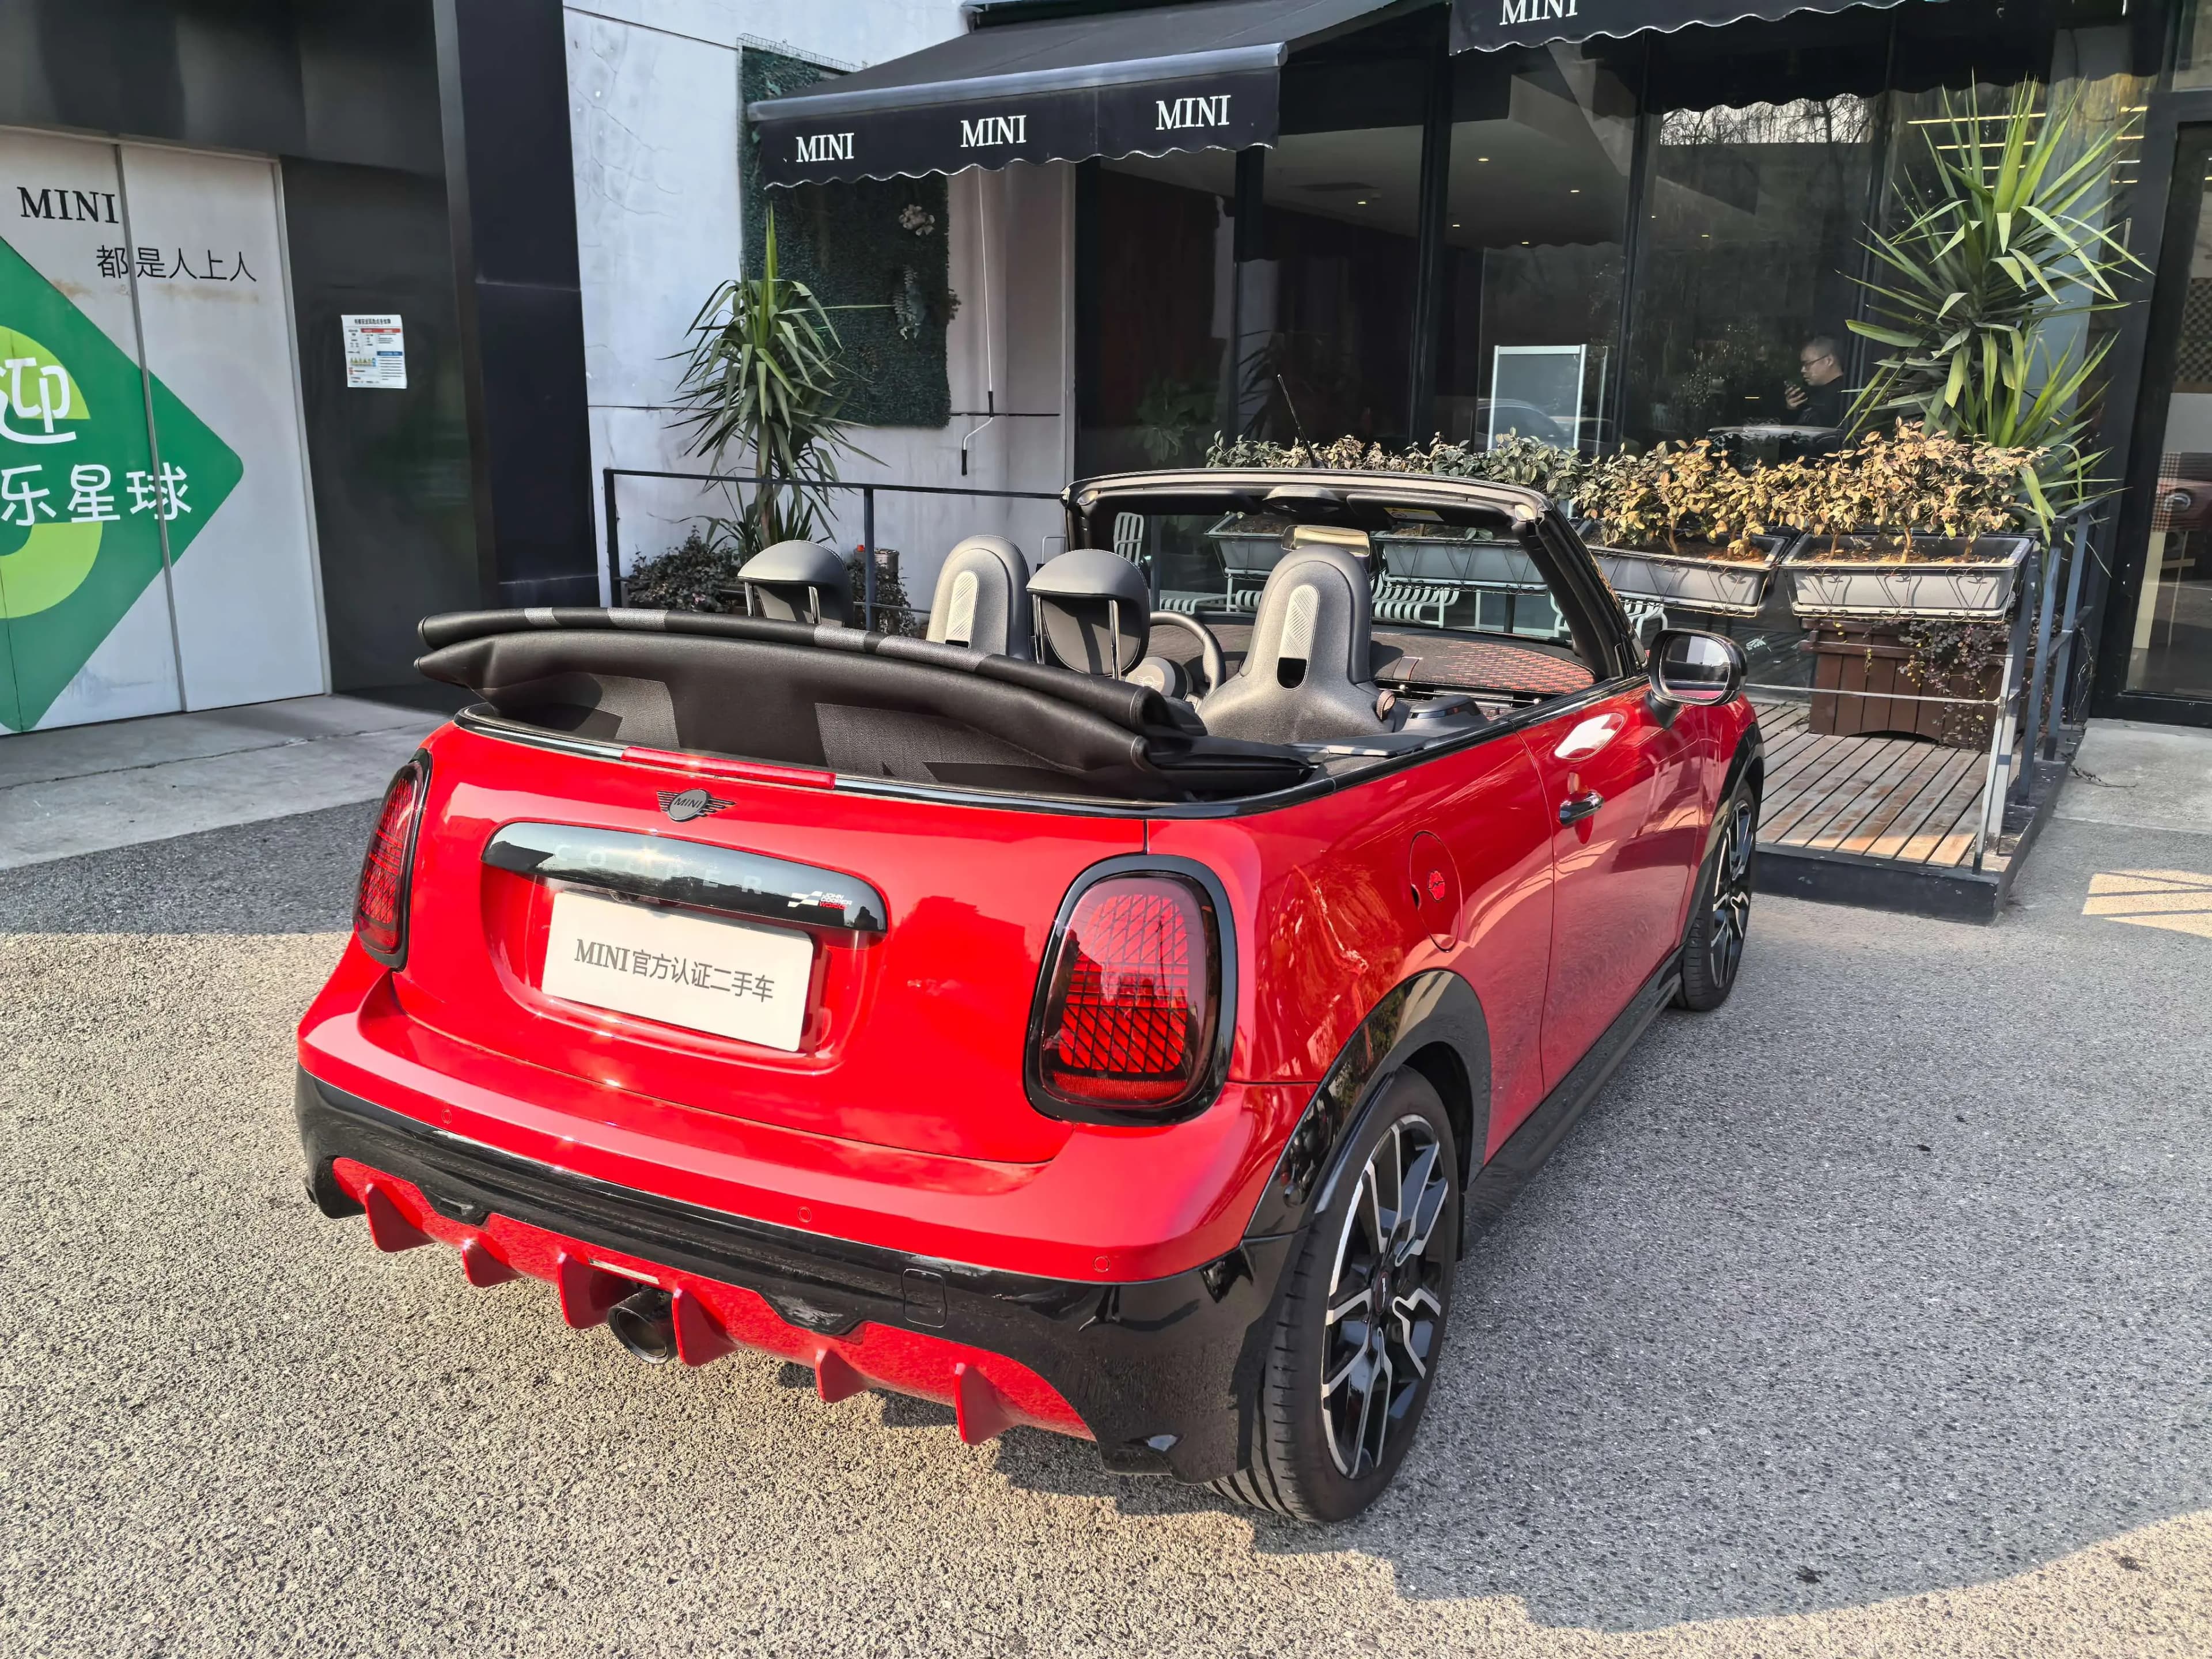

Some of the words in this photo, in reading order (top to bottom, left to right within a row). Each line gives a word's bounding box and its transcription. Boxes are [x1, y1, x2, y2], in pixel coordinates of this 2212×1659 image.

[1499, 0, 1578, 25] MINI
[1156, 95, 1231, 130] MINI
[796, 132, 854, 162] MINI
[960, 115, 1027, 148] MINI
[17, 187, 119, 224] MINI
[96, 245, 257, 281] 都是人上人
[1, 462, 192, 526] 乐星球
[674, 798, 703, 808] MINI
[820, 902, 847, 910] WORKS
